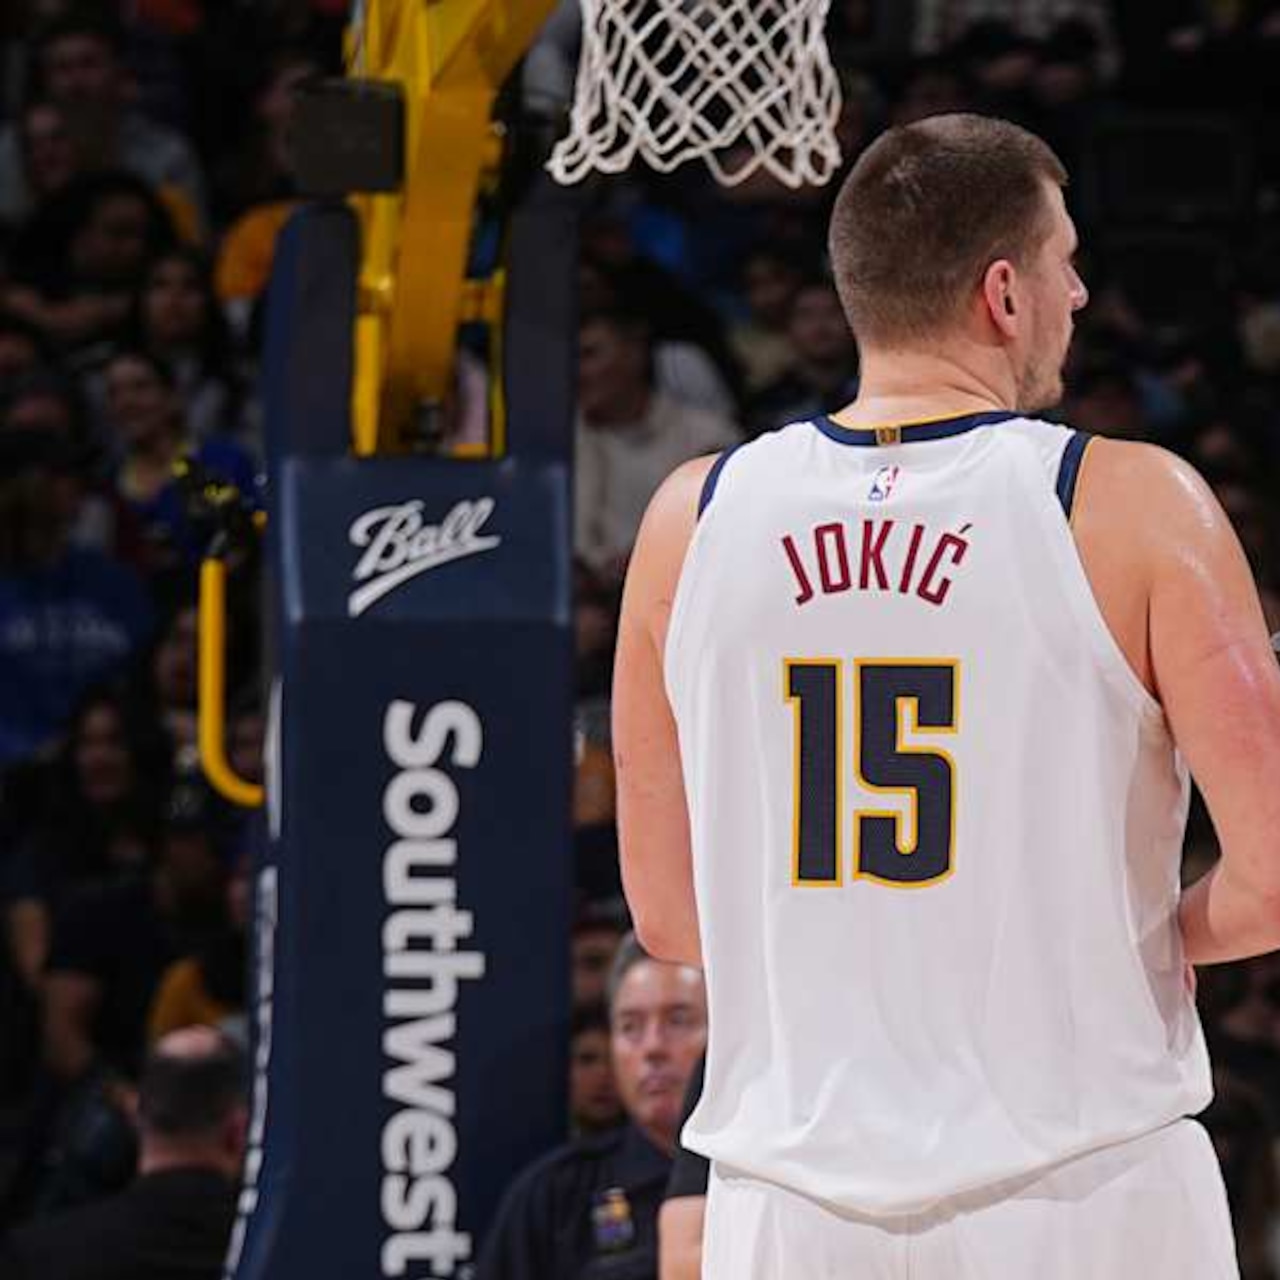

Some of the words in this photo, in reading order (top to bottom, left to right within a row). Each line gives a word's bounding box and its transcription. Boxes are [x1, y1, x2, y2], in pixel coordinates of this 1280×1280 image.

[348, 497, 500, 616] Ball
[781, 519, 973, 606] JOKIĆ
[782, 656, 961, 888] 15
[382, 699, 485, 1277] Southwest
